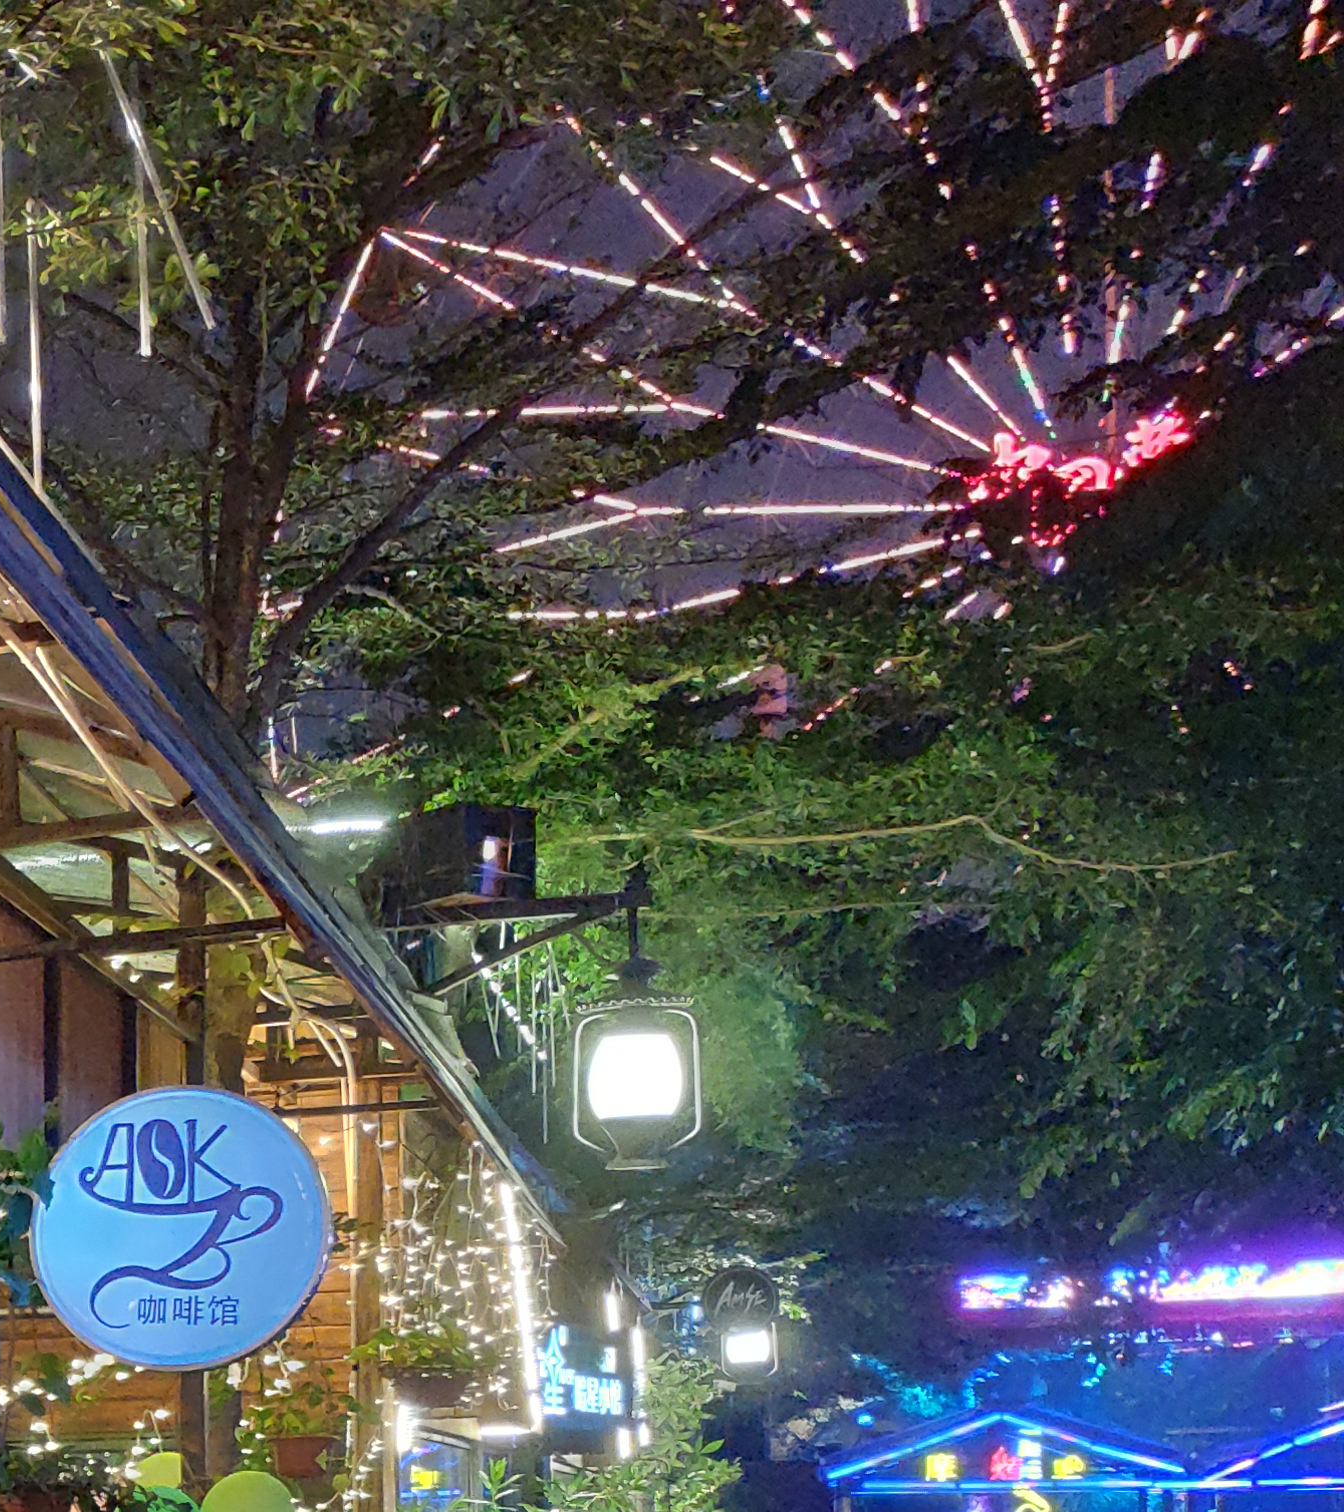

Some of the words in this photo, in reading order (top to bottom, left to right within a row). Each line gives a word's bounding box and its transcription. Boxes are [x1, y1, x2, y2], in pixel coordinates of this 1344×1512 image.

[79, 1118, 242, 1205] AOK
[136, 1294, 240, 1326] 咖啡馆
